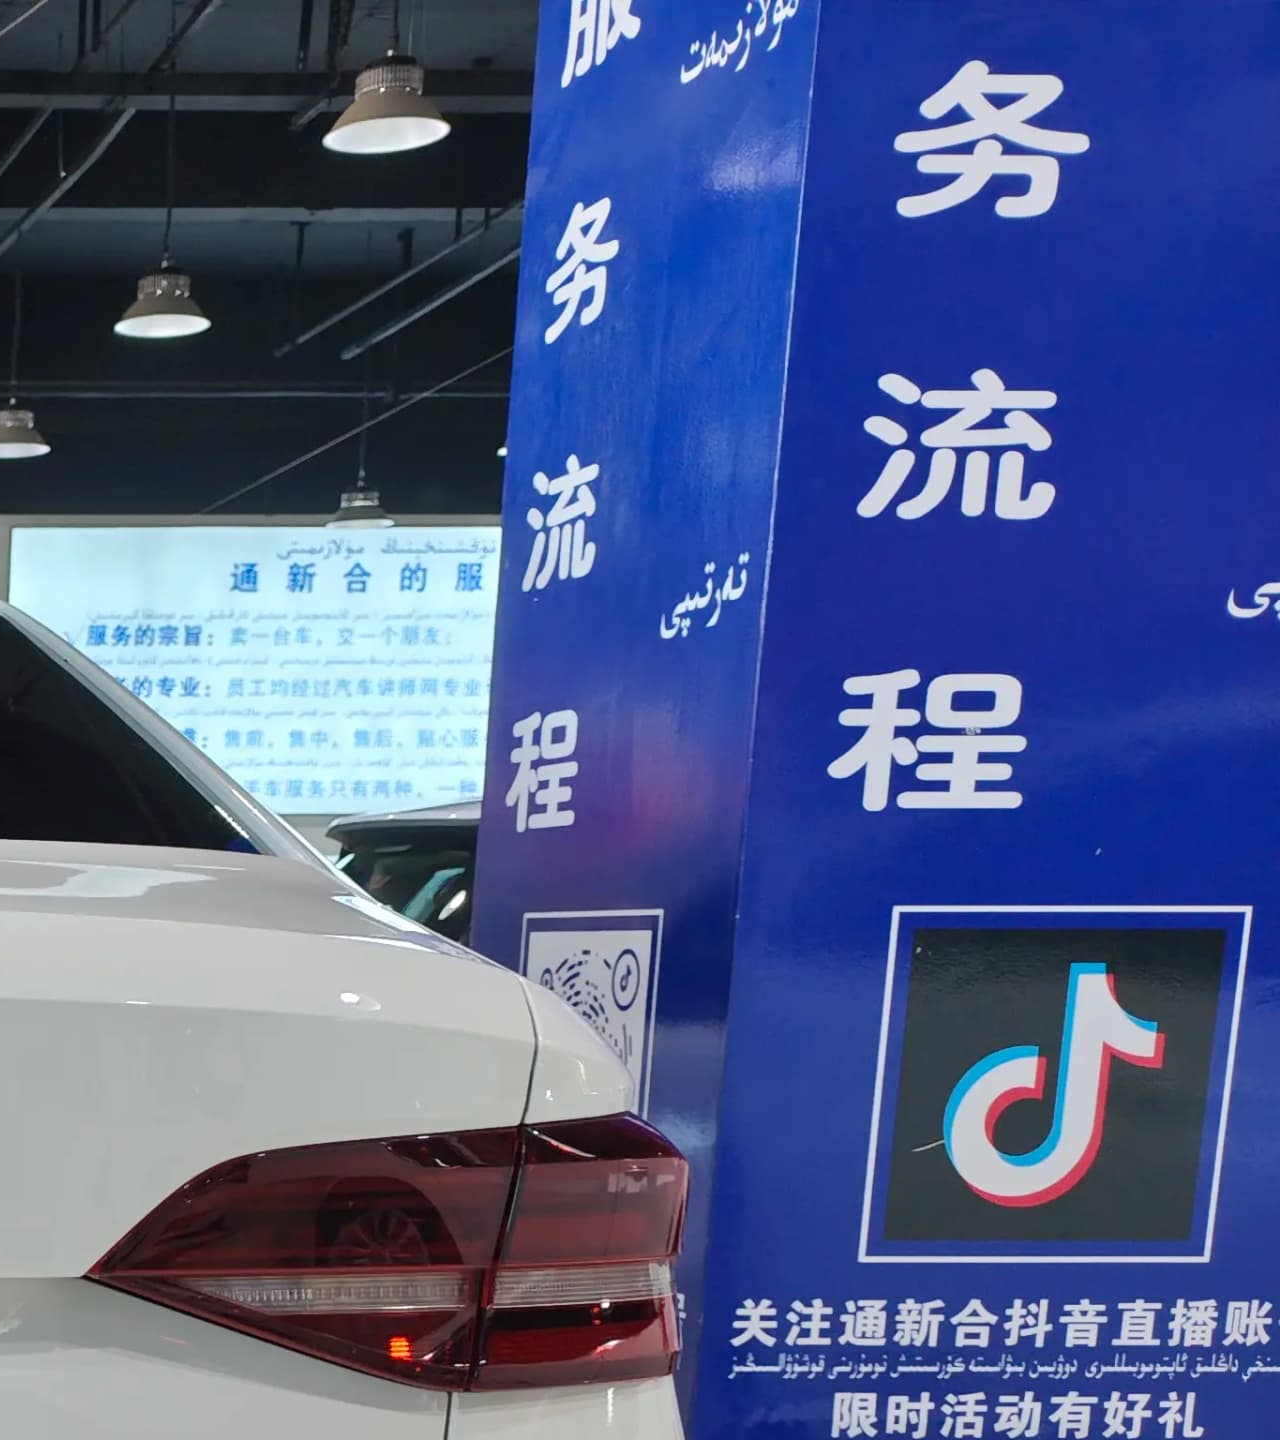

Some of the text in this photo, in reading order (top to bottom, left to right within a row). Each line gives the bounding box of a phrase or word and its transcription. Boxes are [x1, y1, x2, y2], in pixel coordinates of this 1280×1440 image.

[730, 1298, 1280, 1348] 关注通新合抖音直播账
[831, 1391, 1205, 1439] 限时活动有好礼
